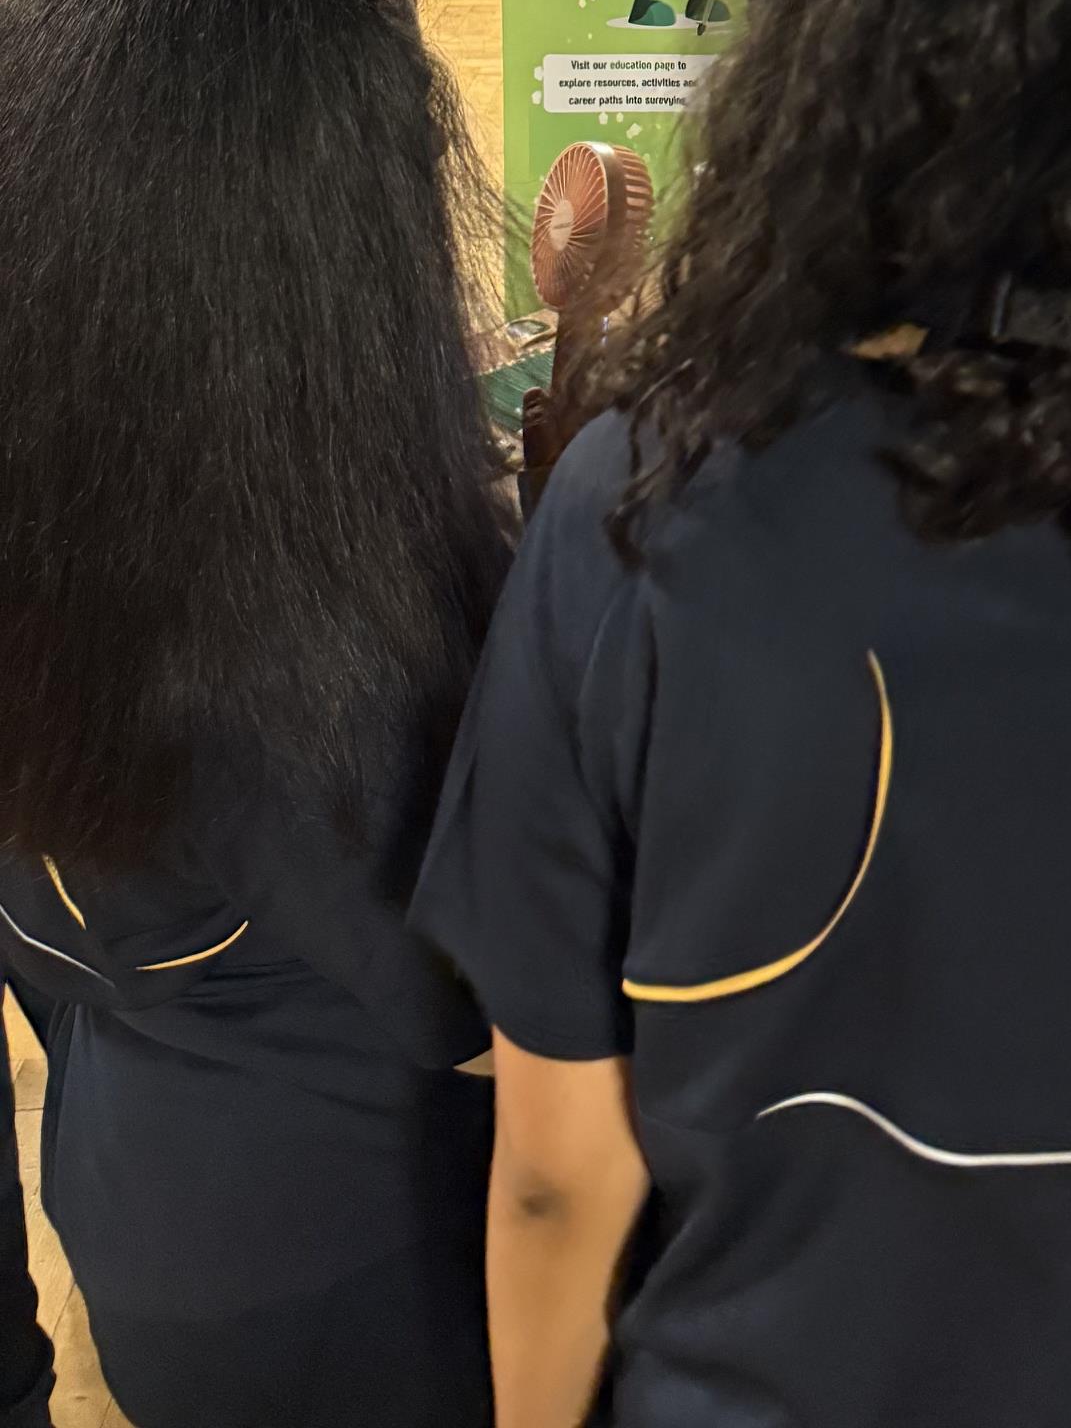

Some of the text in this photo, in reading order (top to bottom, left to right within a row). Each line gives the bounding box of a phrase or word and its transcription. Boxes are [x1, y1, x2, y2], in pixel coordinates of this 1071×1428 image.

[570, 59, 687, 72] Visit our education page to
[559, 78, 591, 89] explore
[594, 80, 639, 89] resources,
[641, 77, 681, 88] activities
[568, 96, 596, 106] career
[599, 95, 624, 107] paths
[625, 95, 643, 105] into
